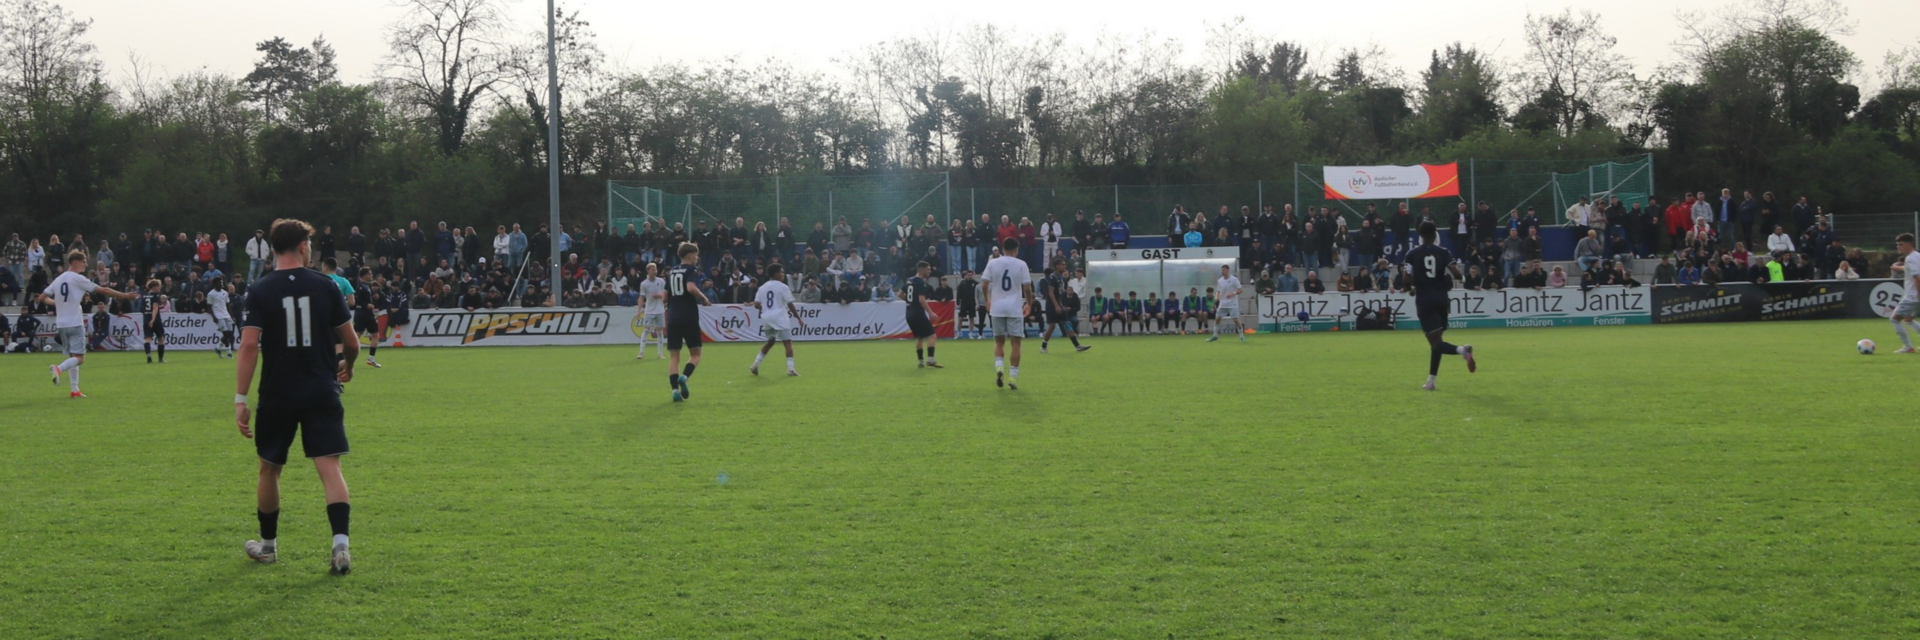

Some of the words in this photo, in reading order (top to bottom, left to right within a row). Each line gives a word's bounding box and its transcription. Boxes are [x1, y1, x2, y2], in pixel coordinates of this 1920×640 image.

[1352, 177, 1368, 186] bfv
[1141, 248, 1181, 259] GAST
[1423, 255, 1436, 278] 9
[670, 273, 684, 297] 10
[1001, 269, 1012, 291] 6
[60, 281, 69, 303] 9
[766, 290, 774, 308] 8
[907, 285, 914, 302] 8
[1448, 292, 1485, 314] ntz
[1496, 290, 1564, 314] Jantz
[1575, 288, 1644, 312] Jantz
[1761, 291, 1845, 314] SCHMITT
[145, 298, 151, 311] 3
[1263, 295, 1329, 318] Jantz
[1340, 294, 1406, 316] Jantz
[1660, 293, 1742, 316] SCHMITT
[162, 316, 207, 328] discher
[282, 296, 312, 347] 11
[414, 312, 608, 344] KNIPPSCHILD
[721, 316, 745, 329] bfv
[758, 323, 861, 337] Fallverband
[863, 323, 885, 335] e.V.
[1280, 323, 1312, 332] Fenster
[1448, 320, 1468, 328] nster
[1506, 317, 1553, 328] Haustüren
[1593, 316, 1626, 326] Fenster
